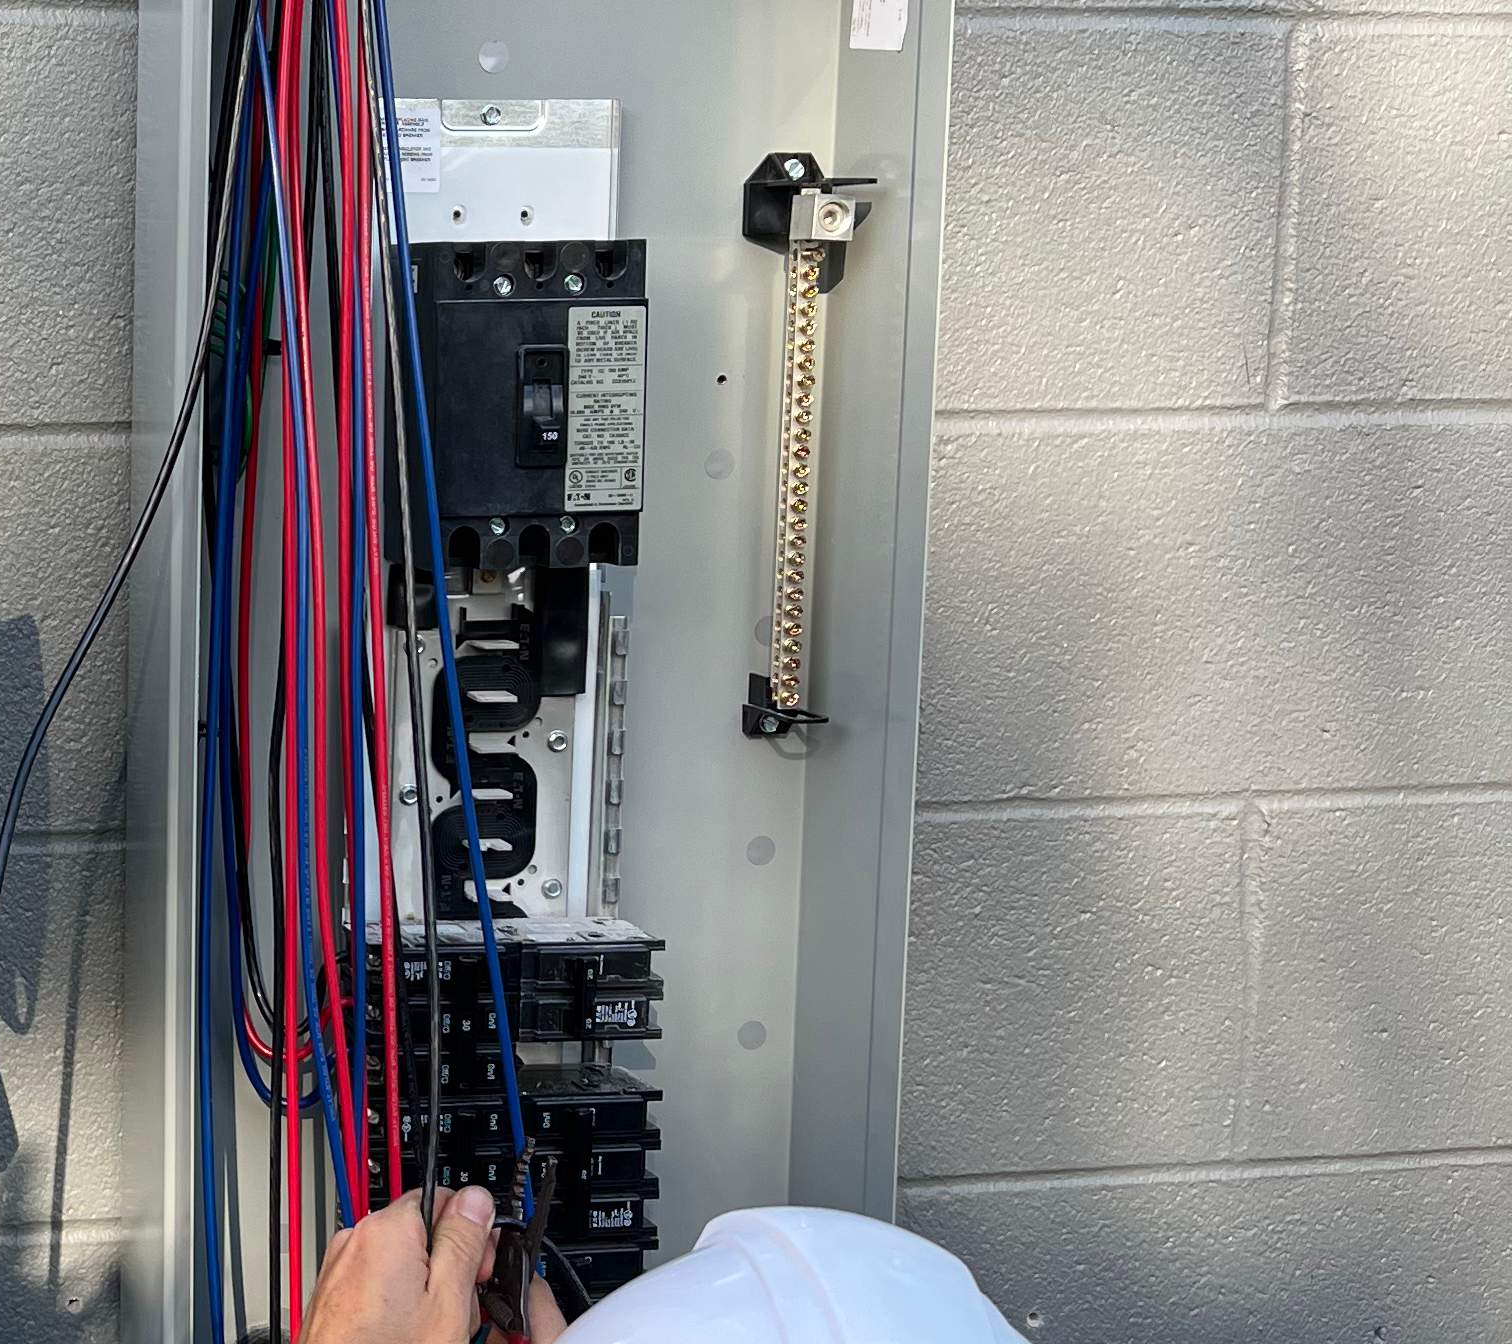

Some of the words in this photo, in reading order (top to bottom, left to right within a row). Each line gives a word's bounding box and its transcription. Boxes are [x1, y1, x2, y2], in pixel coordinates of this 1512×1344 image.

[542, 431, 558, 441] 150
[462, 1019, 471, 1032] 30
[460, 1172, 469, 1183] 30
